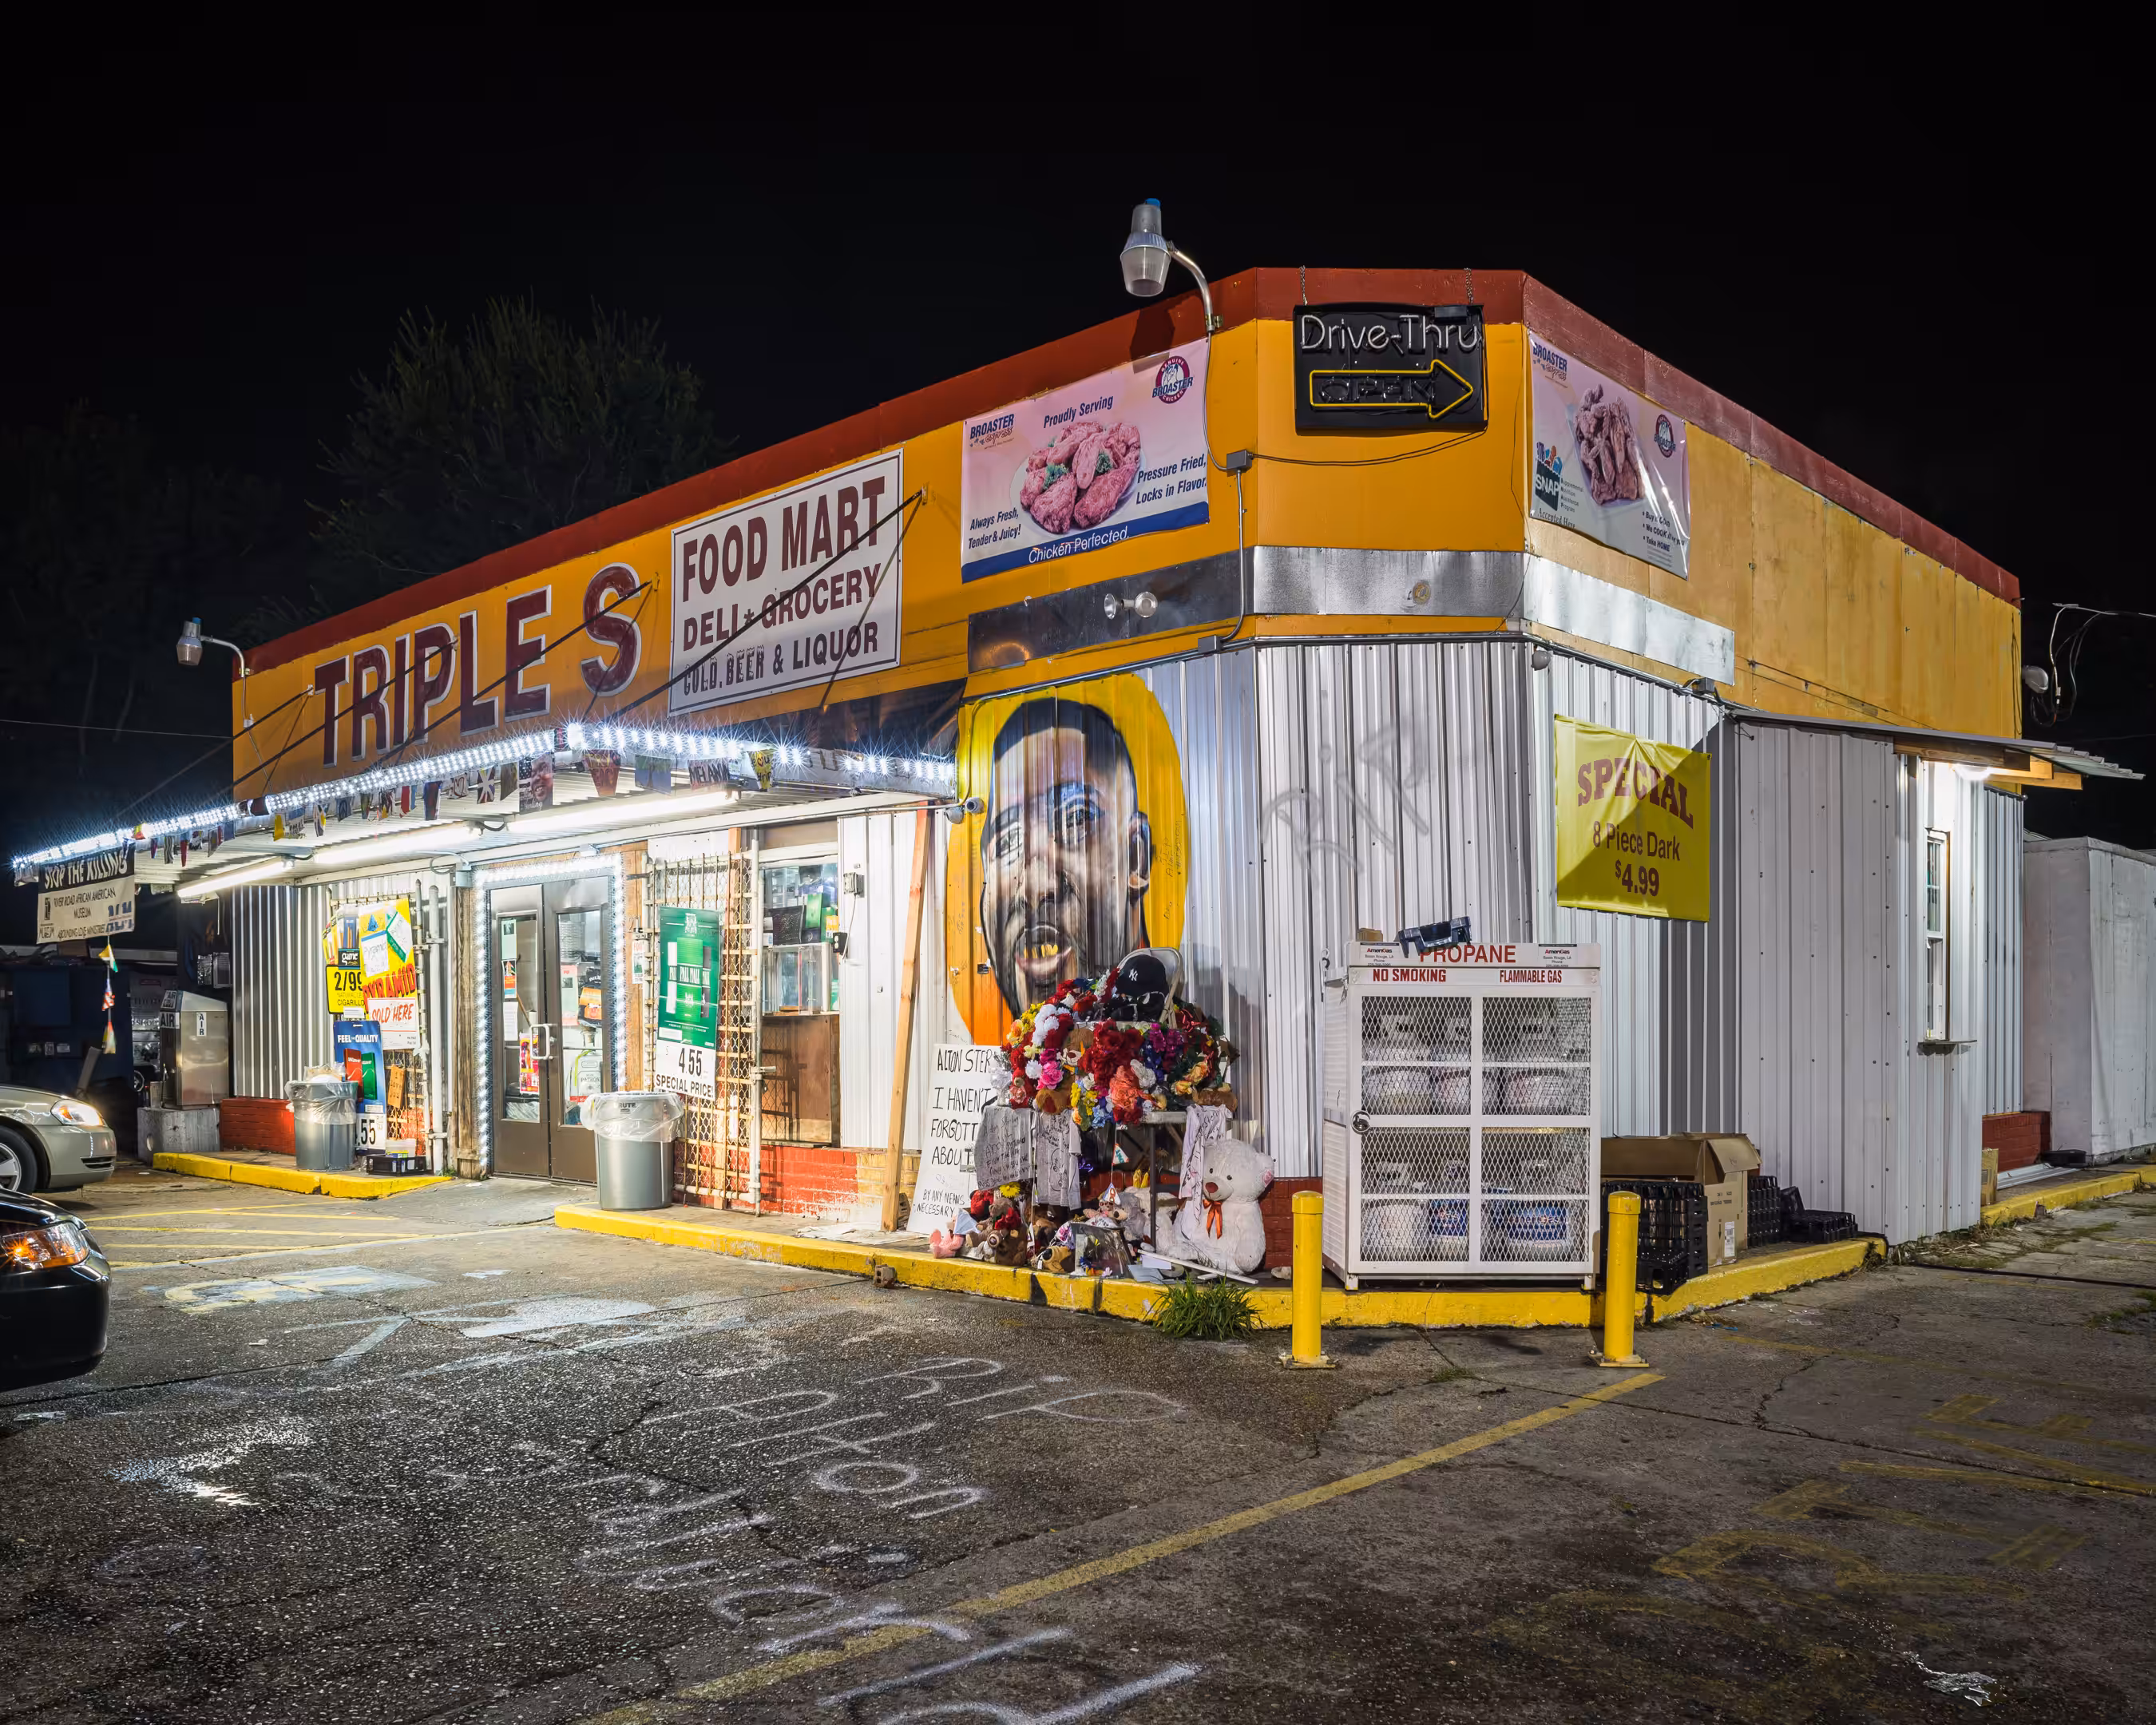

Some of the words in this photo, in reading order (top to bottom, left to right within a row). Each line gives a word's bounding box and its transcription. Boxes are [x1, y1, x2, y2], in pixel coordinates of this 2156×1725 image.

[1301, 315, 1479, 350] Drive-Thru
[1161, 358, 1185, 371] GENUINE
[1533, 342, 1567, 372] BROASTER
[1152, 377, 1193, 398] BROASTER
[1162, 390, 1184, 402] CHICKEN
[1044, 407, 1076, 428] Proudly
[1080, 396, 1114, 416] Serving
[970, 414, 1014, 438] BROASTER
[985, 427, 1013, 445] express
[1137, 462, 1178, 484] Pressure
[1180, 453, 1207, 473] Fried,
[1136, 487, 1163, 505] Locks
[1166, 484, 1175, 497] in
[1177, 477, 1207, 494] Flavor.
[1536, 474, 1560, 496] SNAP
[970, 515, 995, 531] Always
[997, 507, 1019, 523] Fresh,
[1539, 508, 1562, 525] Accepted
[683, 515, 768, 603] FOOD
[781, 475, 886, 572] MART
[969, 532, 992, 549] Tender
[992, 533, 998, 544] &
[999, 524, 1021, 541] Juicy!
[1653, 527, 1667, 537] COOK
[1028, 543, 1072, 564] Chicken
[1074, 526, 1130, 551] Perfected.
[1657, 540, 1671, 552] HOME
[683, 604, 739, 651] DELI
[762, 563, 882, 629] GROCERY
[315, 584, 552, 769] TRIPLE
[581, 561, 642, 697] S
[726, 645, 764, 685] BEER
[773, 644, 784, 675] &
[793, 622, 878, 670] LIQUOR
[1577, 757, 1694, 830] SPECIAL
[1593, 820, 1601, 848] 8
[1606, 823, 1643, 855] Piece
[1647, 831, 1681, 861] Dark
[45, 863, 65, 890] STOP
[68, 859, 85, 885] THE
[87, 850, 128, 881] KILLING
[1615, 859, 1660, 897] $4.99
[54, 896, 64, 908] RIVER
[64, 894, 76, 906] ROAD
[76, 891, 91, 905] AFRICAN
[91, 887, 117, 902] AMERICAN
[74, 906, 92, 919] MUSEUM
[1420, 945, 1516, 963] PROPANE
[1373, 969, 1389, 981] NO
[1392, 968, 1447, 982] SMOKING
[1500, 970, 1545, 983] FLAMMABLE
[1548, 970, 1562, 983] GAS
[363, 963, 416, 1014] PYRAMID
[161, 1013, 175, 1028] AIR
[371, 1007, 391, 1023] SOLD
[393, 1003, 414, 1022] HERE
[355, 1034, 378, 1043] QUALITY
[937, 1049, 961, 1073] ALTON
[964, 1049, 992, 1073] STER
[656, 1074, 688, 1092] SPECIAL
[932, 1087, 944, 1110] I
[948, 1087, 991, 1113] HAVEN'T
[355, 1118, 376, 1146] .55
[930, 1118, 979, 1142] FORGOTT
[931, 1145, 973, 1166] ABOUT
[922, 1188, 932, 1200] BY
[932, 1189, 943, 1202] ANY
[944, 1192, 965, 1206] MEANS
[916, 1203, 956, 1218] NECESSARY
